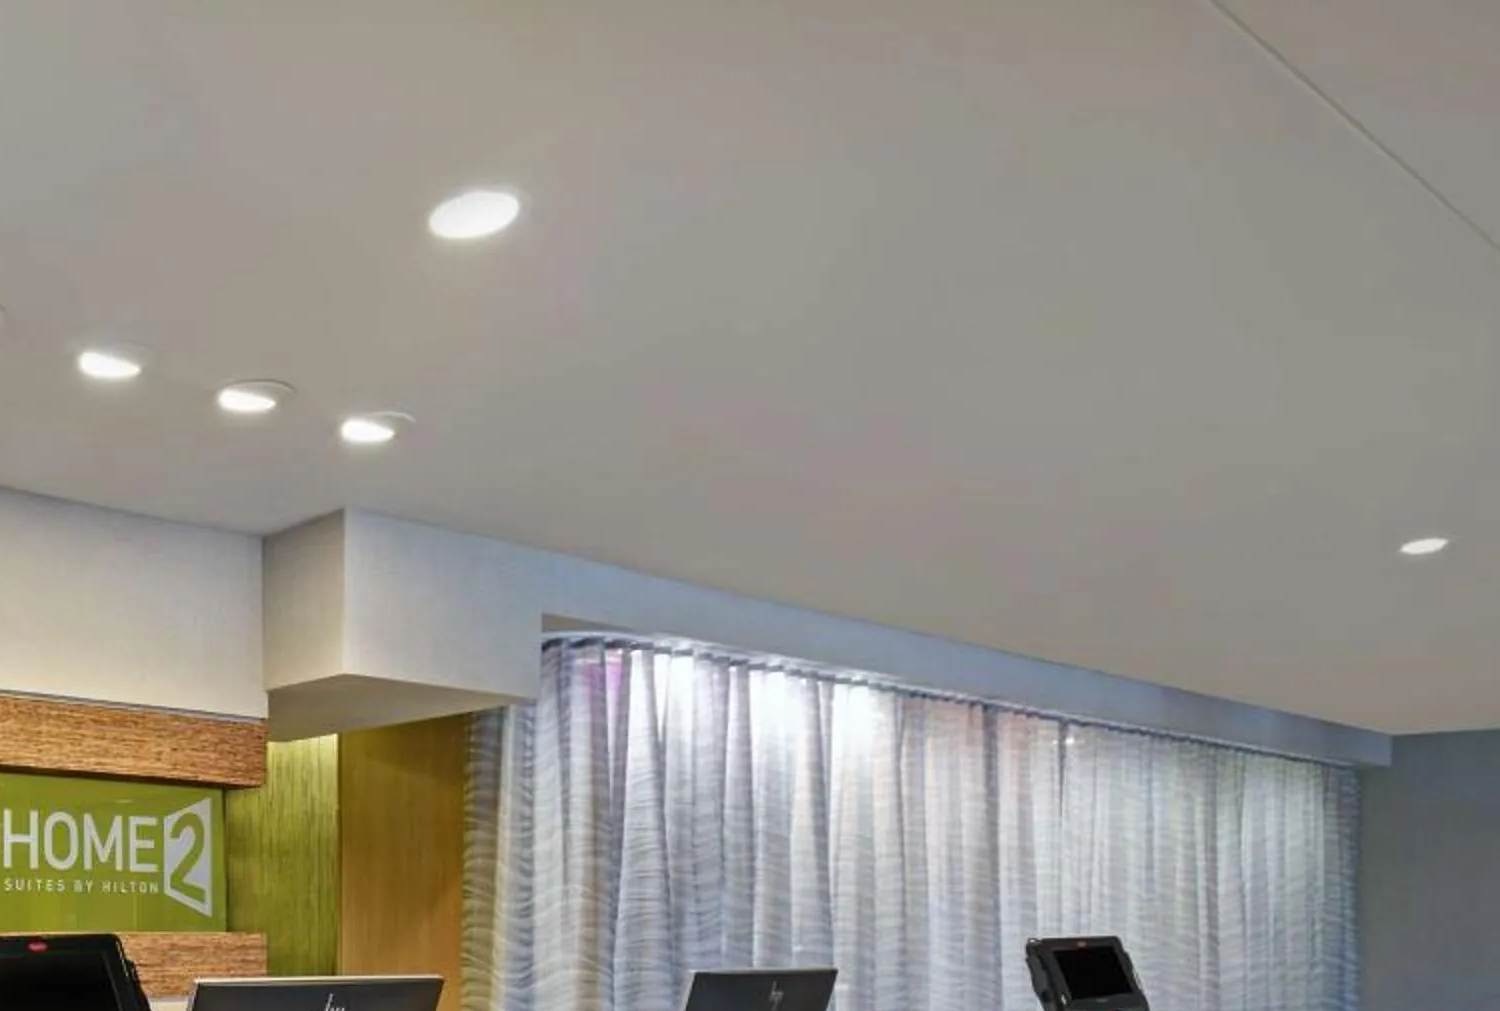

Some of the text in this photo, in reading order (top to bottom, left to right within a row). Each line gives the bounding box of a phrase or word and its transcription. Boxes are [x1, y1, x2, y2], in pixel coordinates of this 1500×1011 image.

[3, 878, 160, 894] SUITES BY HILTON
